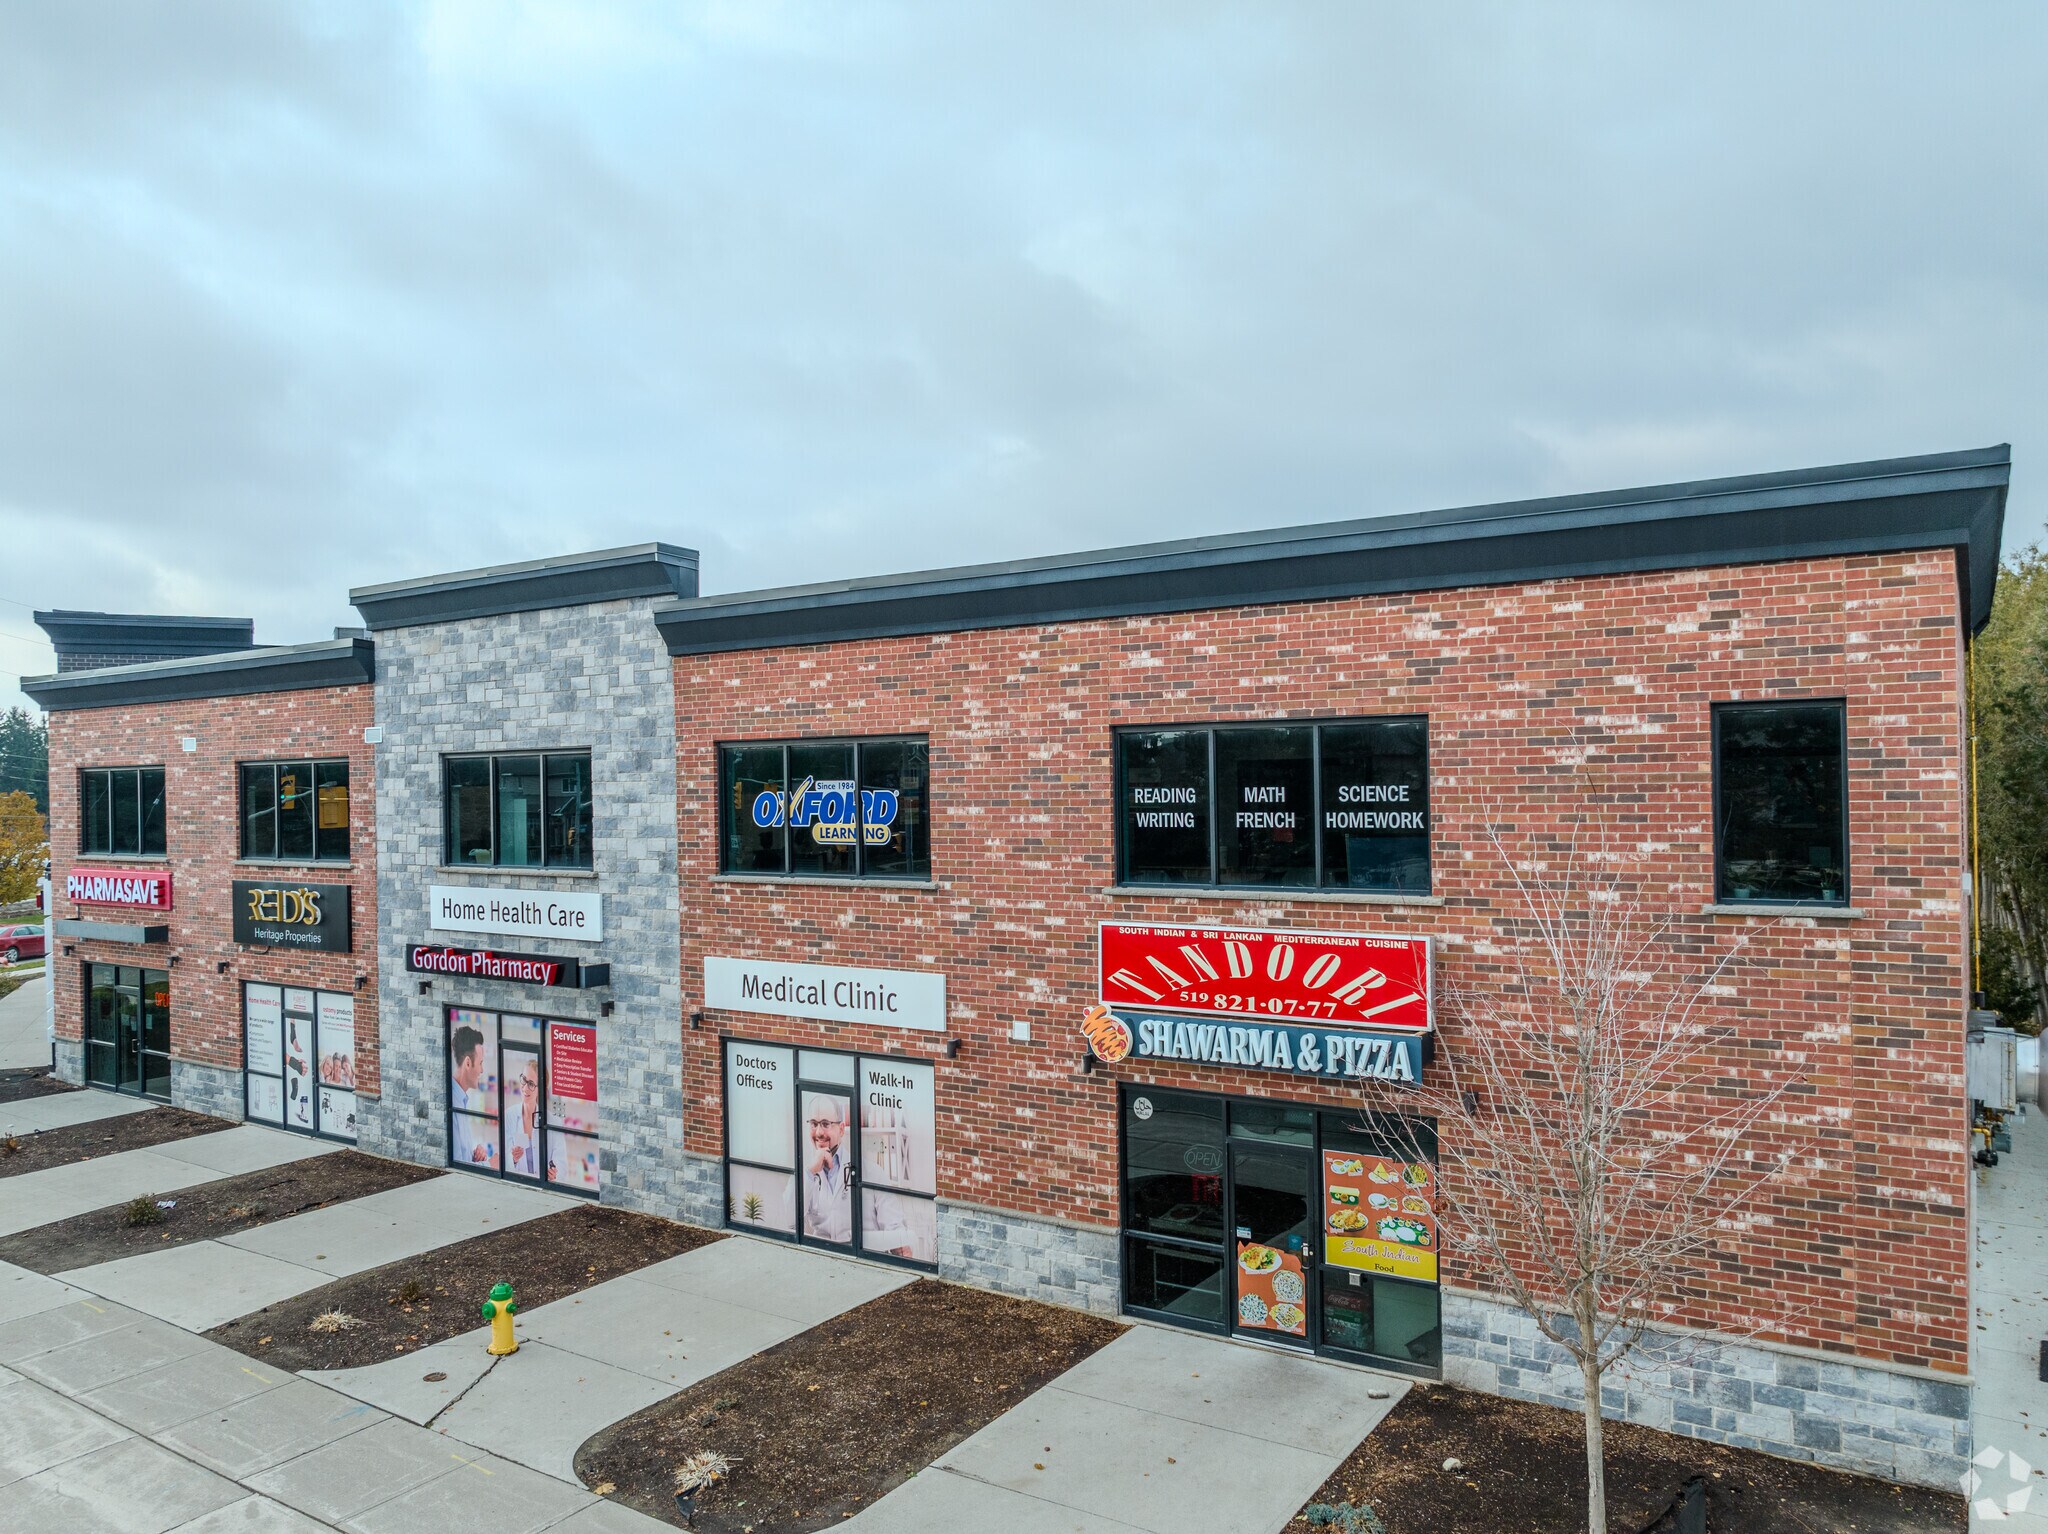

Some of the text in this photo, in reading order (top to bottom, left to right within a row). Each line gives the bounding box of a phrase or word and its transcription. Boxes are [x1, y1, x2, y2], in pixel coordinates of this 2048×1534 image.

[817, 782, 854, 790] Since 1984
[1244, 786, 1286, 803] MATH
[1338, 785, 1410, 803] SCIENCE
[1134, 787, 1196, 804] READING
[752, 788, 898, 828] OXFORD
[1136, 812, 1195, 829] WRITING
[1235, 811, 1296, 829] FRENCH
[1325, 811, 1425, 829] HOMEWORK
[819, 827, 885, 840] LEARNNG
[67, 875, 159, 905] PHARMASAVE
[442, 897, 586, 928] Home Health Care
[254, 927, 322, 944] Heritage Properties
[1119, 926, 1409, 950] SOUTH INDIAN & SRI LANKAN MEDITERRANEAN CUISINE
[412, 947, 552, 987] Gordon Pharmacy
[1107, 940, 1425, 1020] TANDOORI
[259, 998, 272, 1006] Health
[741, 973, 898, 1013] Medical Clinic
[1180, 990, 1210, 1003] 519
[336, 1008, 353, 1016] products
[553, 1029, 586, 1043] Services
[1138, 1019, 1416, 1082] SHAWARMA & PIZZA
[736, 1054, 777, 1071] Doctors
[736, 1073, 773, 1091] Offices
[868, 1071, 914, 1090] Walk-In
[869, 1092, 903, 1110] Clinic
[1186, 1150, 1221, 1167] OPEN
[1342, 1239, 1420, 1264] South Indian
[1374, 1263, 1395, 1273] Food
